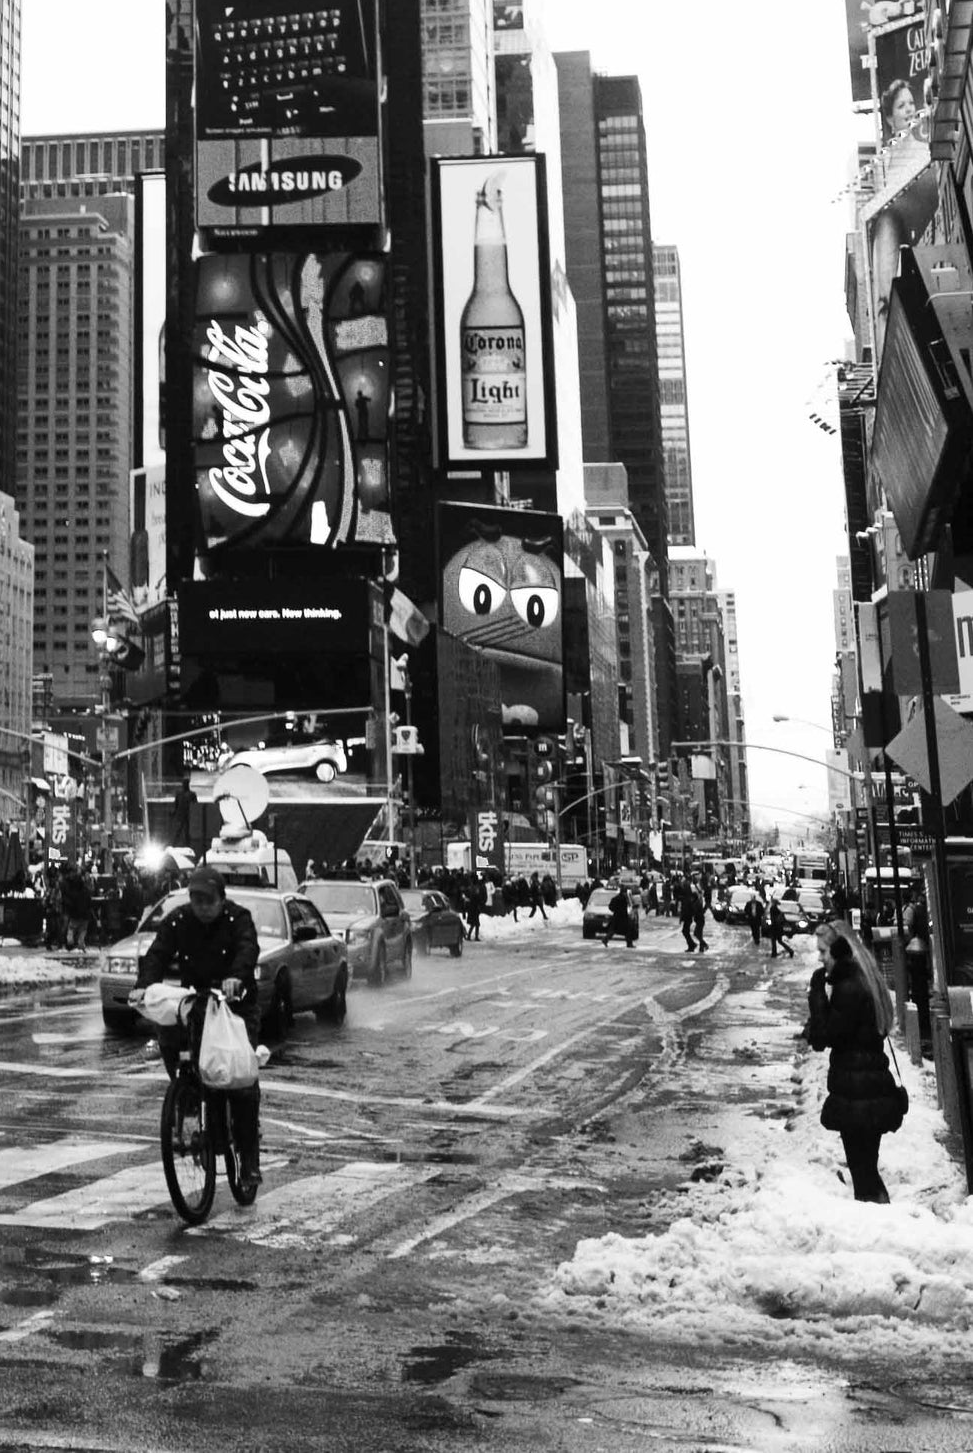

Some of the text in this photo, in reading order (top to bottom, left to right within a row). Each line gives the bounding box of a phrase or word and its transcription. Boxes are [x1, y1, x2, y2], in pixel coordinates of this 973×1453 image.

[464, 332, 522, 355] Corona
[471, 378, 520, 404] Light
[220, 608, 237, 621] just
[303, 607, 342, 620] thinking.
[52, 804, 71, 844] tkts
[477, 810, 498, 852] tkts
